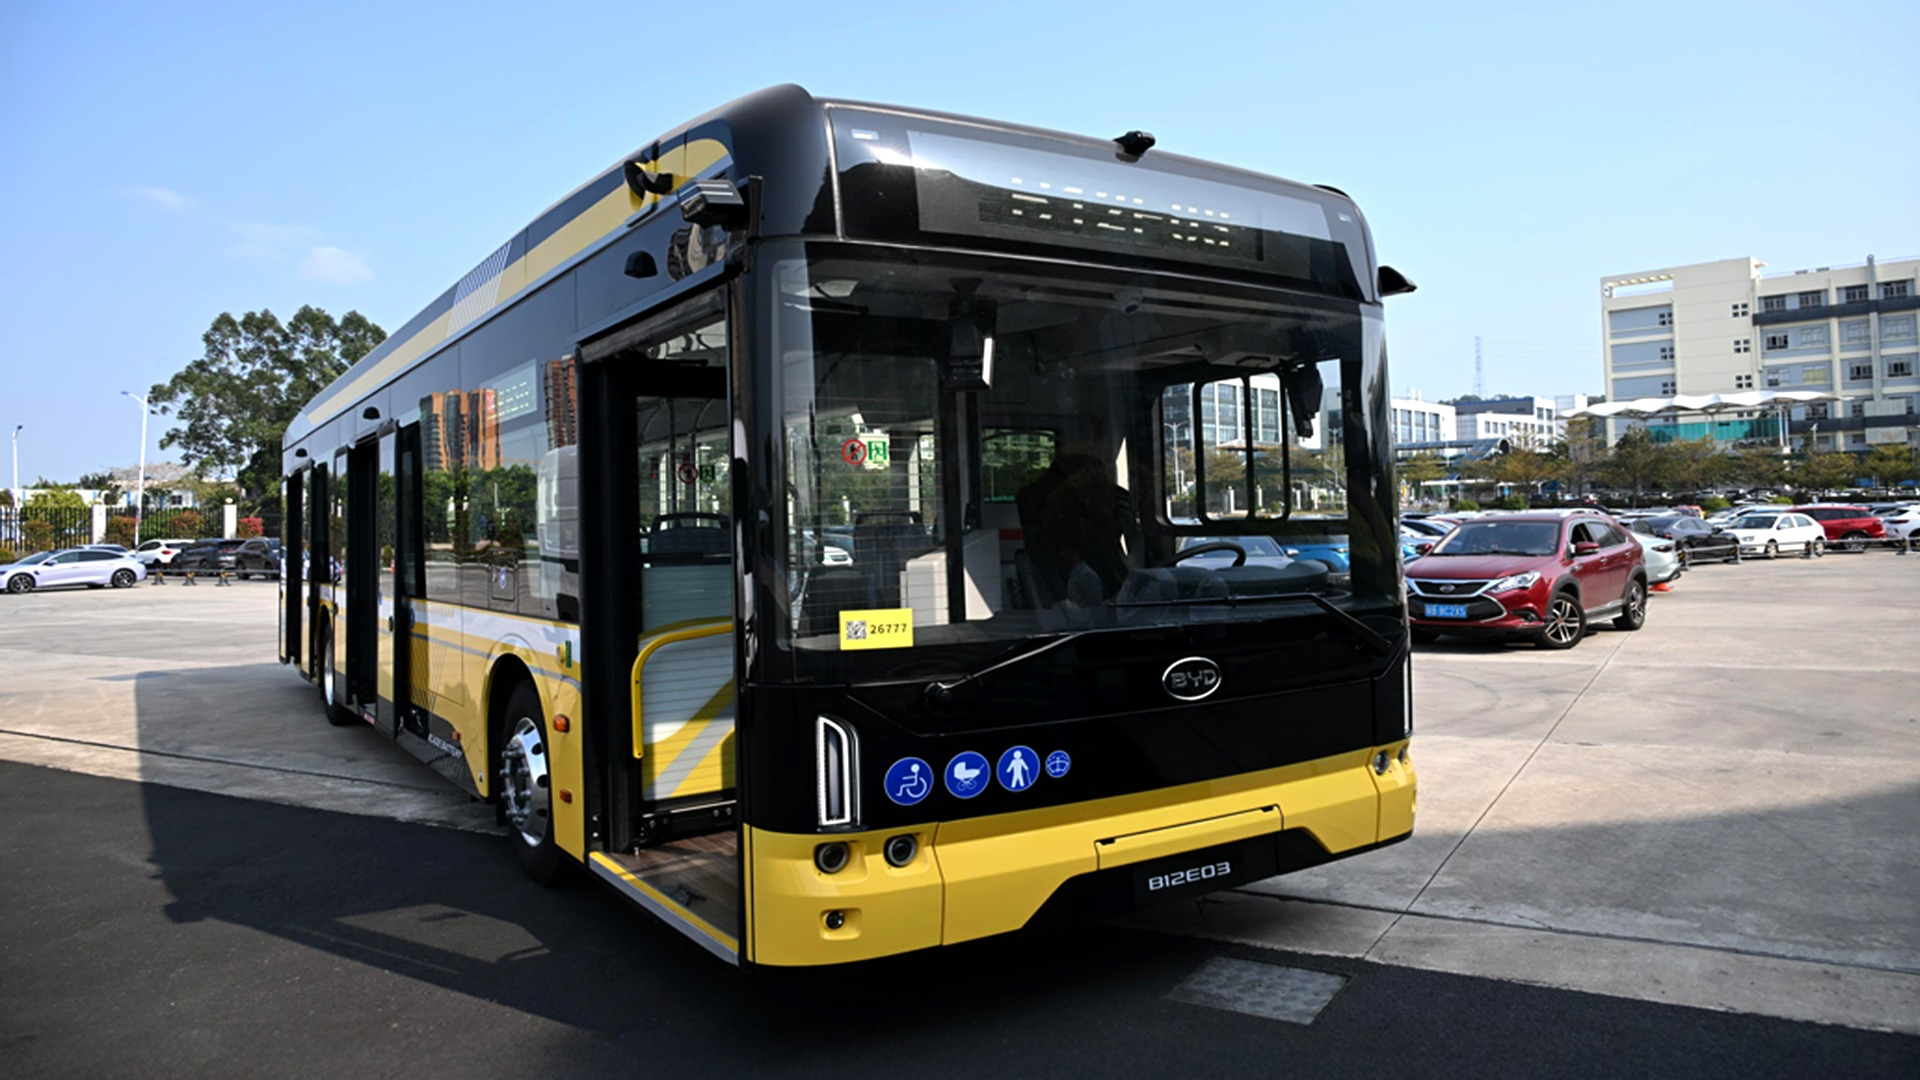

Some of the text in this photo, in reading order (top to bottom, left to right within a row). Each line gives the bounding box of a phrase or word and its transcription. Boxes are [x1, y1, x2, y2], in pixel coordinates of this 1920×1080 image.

[870, 623, 908, 635] 26777
[1171, 669, 1217, 688] BYD
[1148, 861, 1231, 891] B12E03
